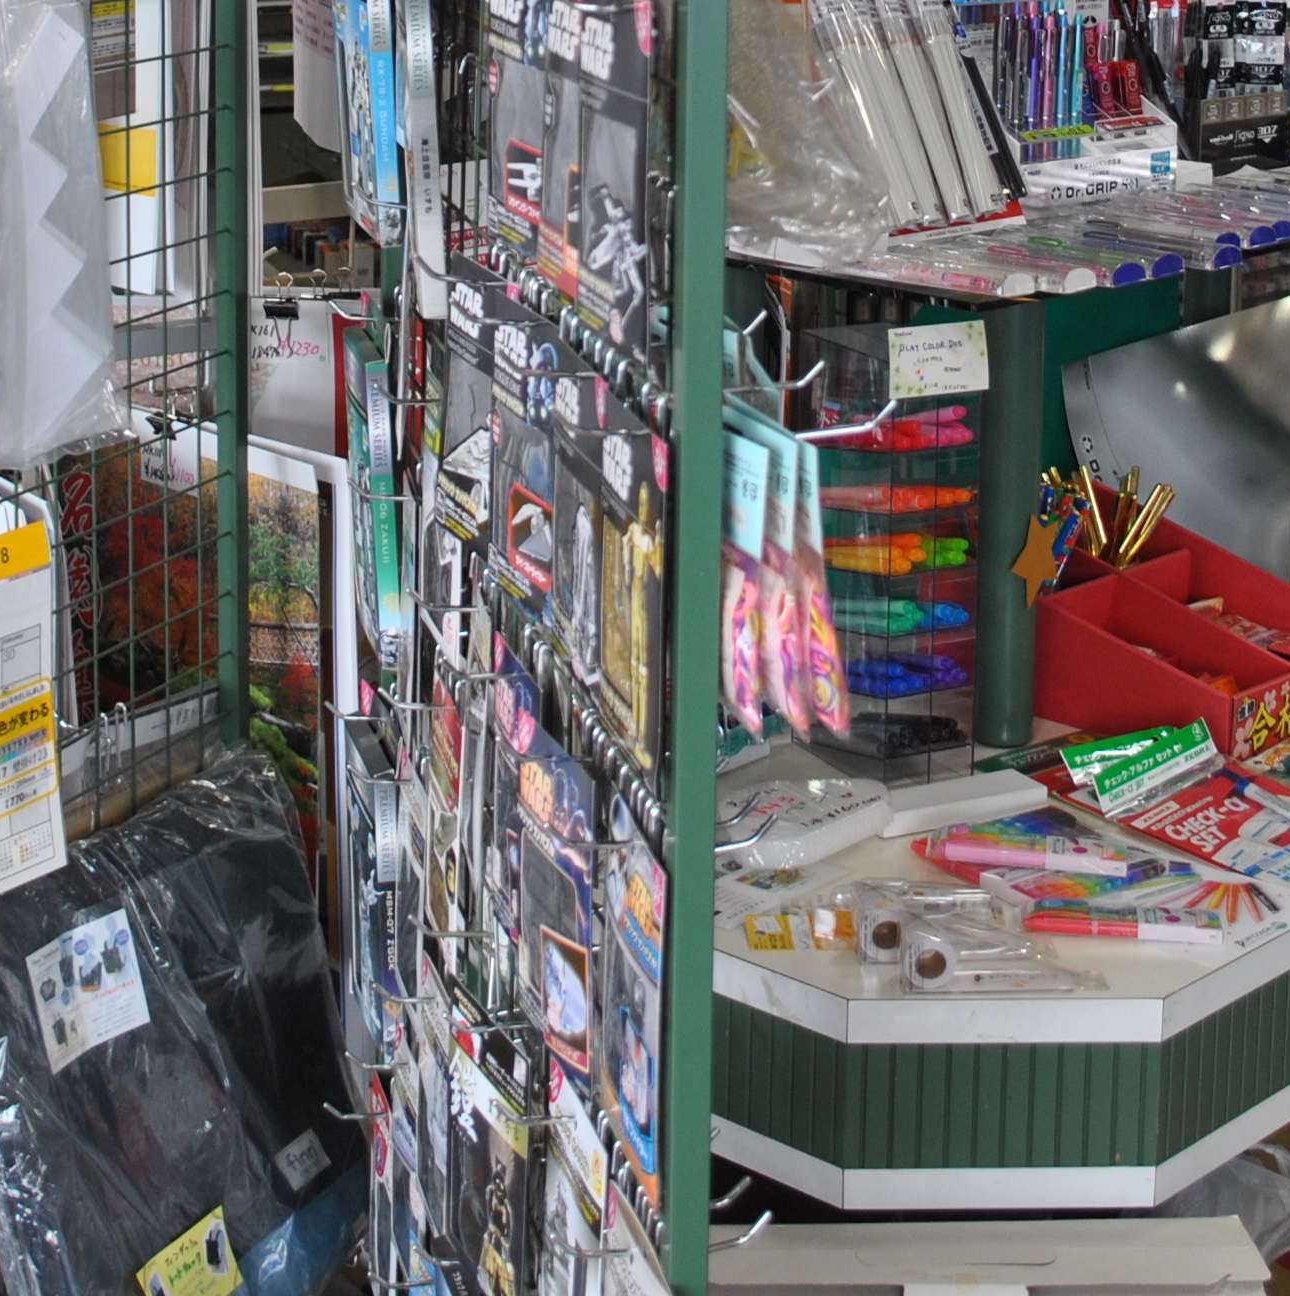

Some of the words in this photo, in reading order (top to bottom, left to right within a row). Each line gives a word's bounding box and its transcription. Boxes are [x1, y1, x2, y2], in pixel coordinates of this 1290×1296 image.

[370, 10, 382, 47] SERIES
[549, 0, 581, 35] STAR
[581, 16, 615, 51] STAR
[547, 25, 580, 62] WARS
[580, 41, 615, 81] WARS
[412, 52, 424, 92] SERIES
[379, 109, 389, 162] GUNDAM
[1065, 180, 1118, 199] Dr.GRIP
[450, 281, 484, 318] STAR
[494, 324, 528, 357] STAR
[372, 436, 384, 468] SERIES
[603, 434, 633, 468] STAR
[602, 459, 633, 503] WARS
[519, 761, 553, 798] STAR
[519, 777, 553, 823] WARS
[1141, 803, 1174, 824] ZEBRA
[1190, 827, 1230, 853] SET
